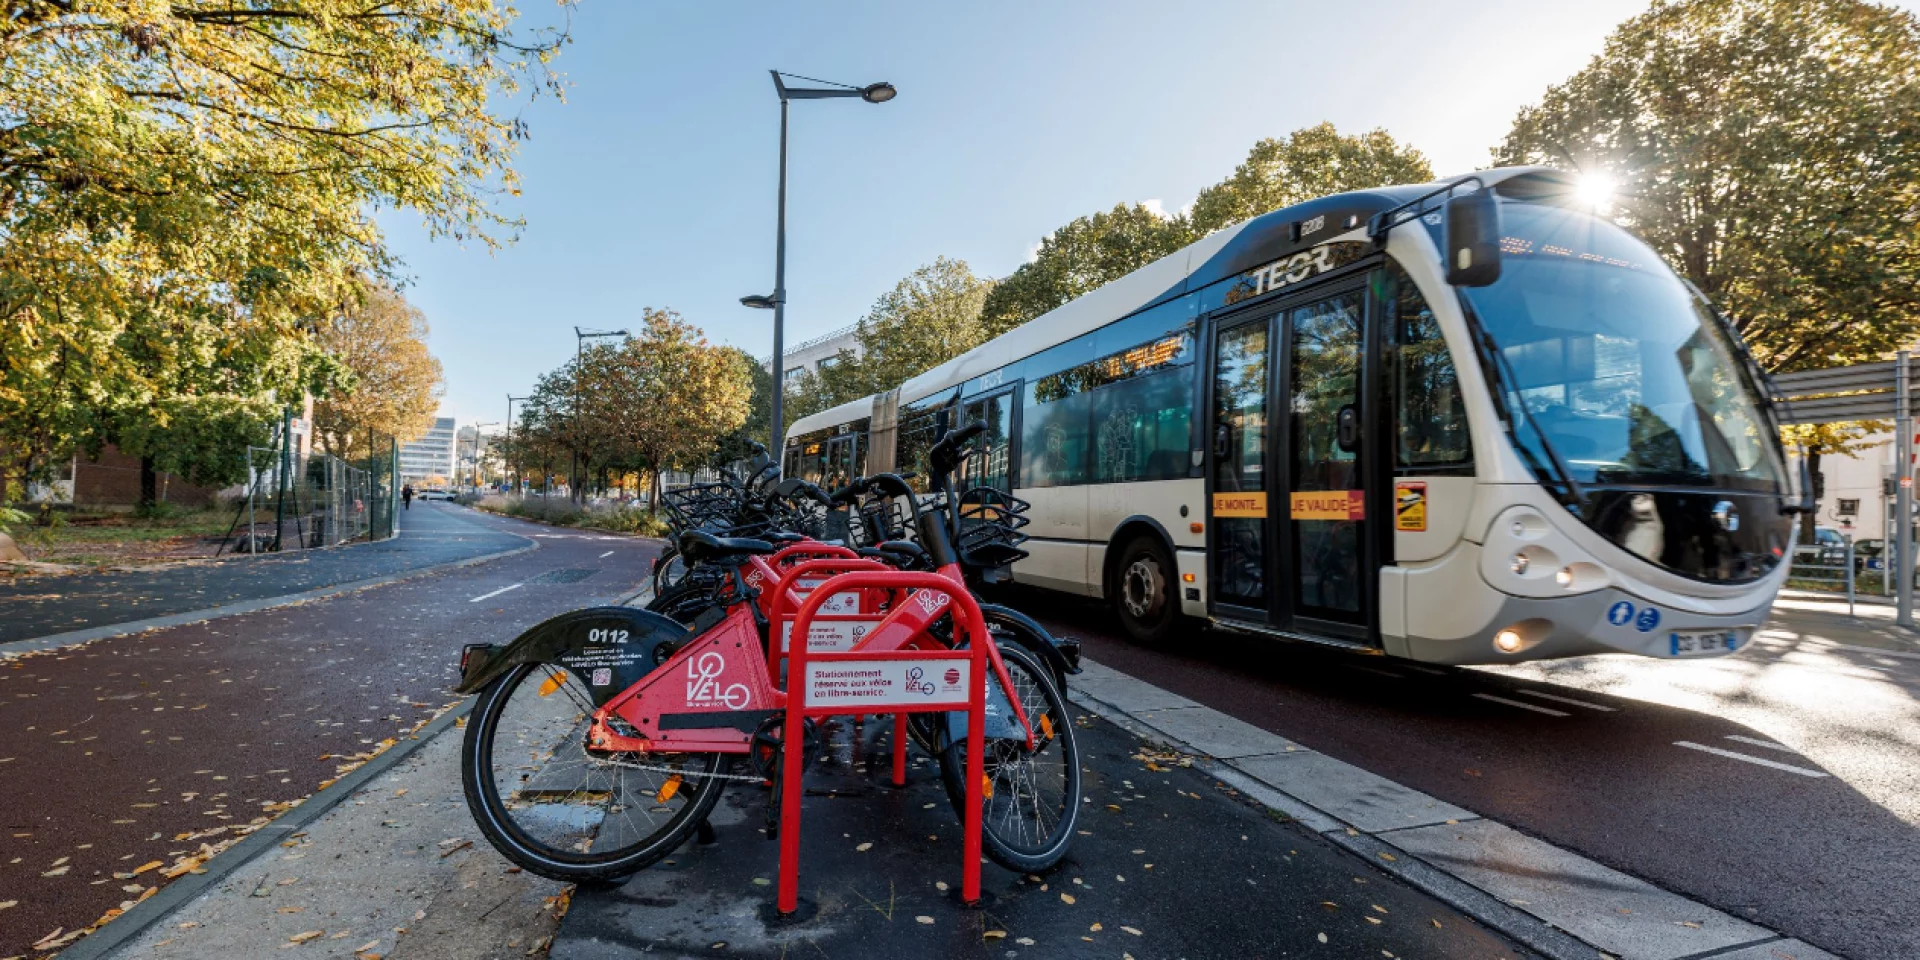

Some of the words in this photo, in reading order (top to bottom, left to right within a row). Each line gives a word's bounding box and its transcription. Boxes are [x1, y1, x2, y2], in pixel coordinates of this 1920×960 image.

[1253, 245, 1334, 295] TEOR
[1213, 499, 1223, 510] JE
[1292, 499, 1304, 511] JE
[1305, 499, 1348, 511] VALIDE
[589, 628, 629, 643] 0112
[688, 652, 724, 679] LO
[814, 669, 882, 679] Stationnement
[814, 680, 848, 688] réservé
[869, 679, 892, 687] vélos
[687, 677, 750, 710] VÉLO
[814, 690, 826, 698] en
[828, 688, 887, 697] libre-service.
